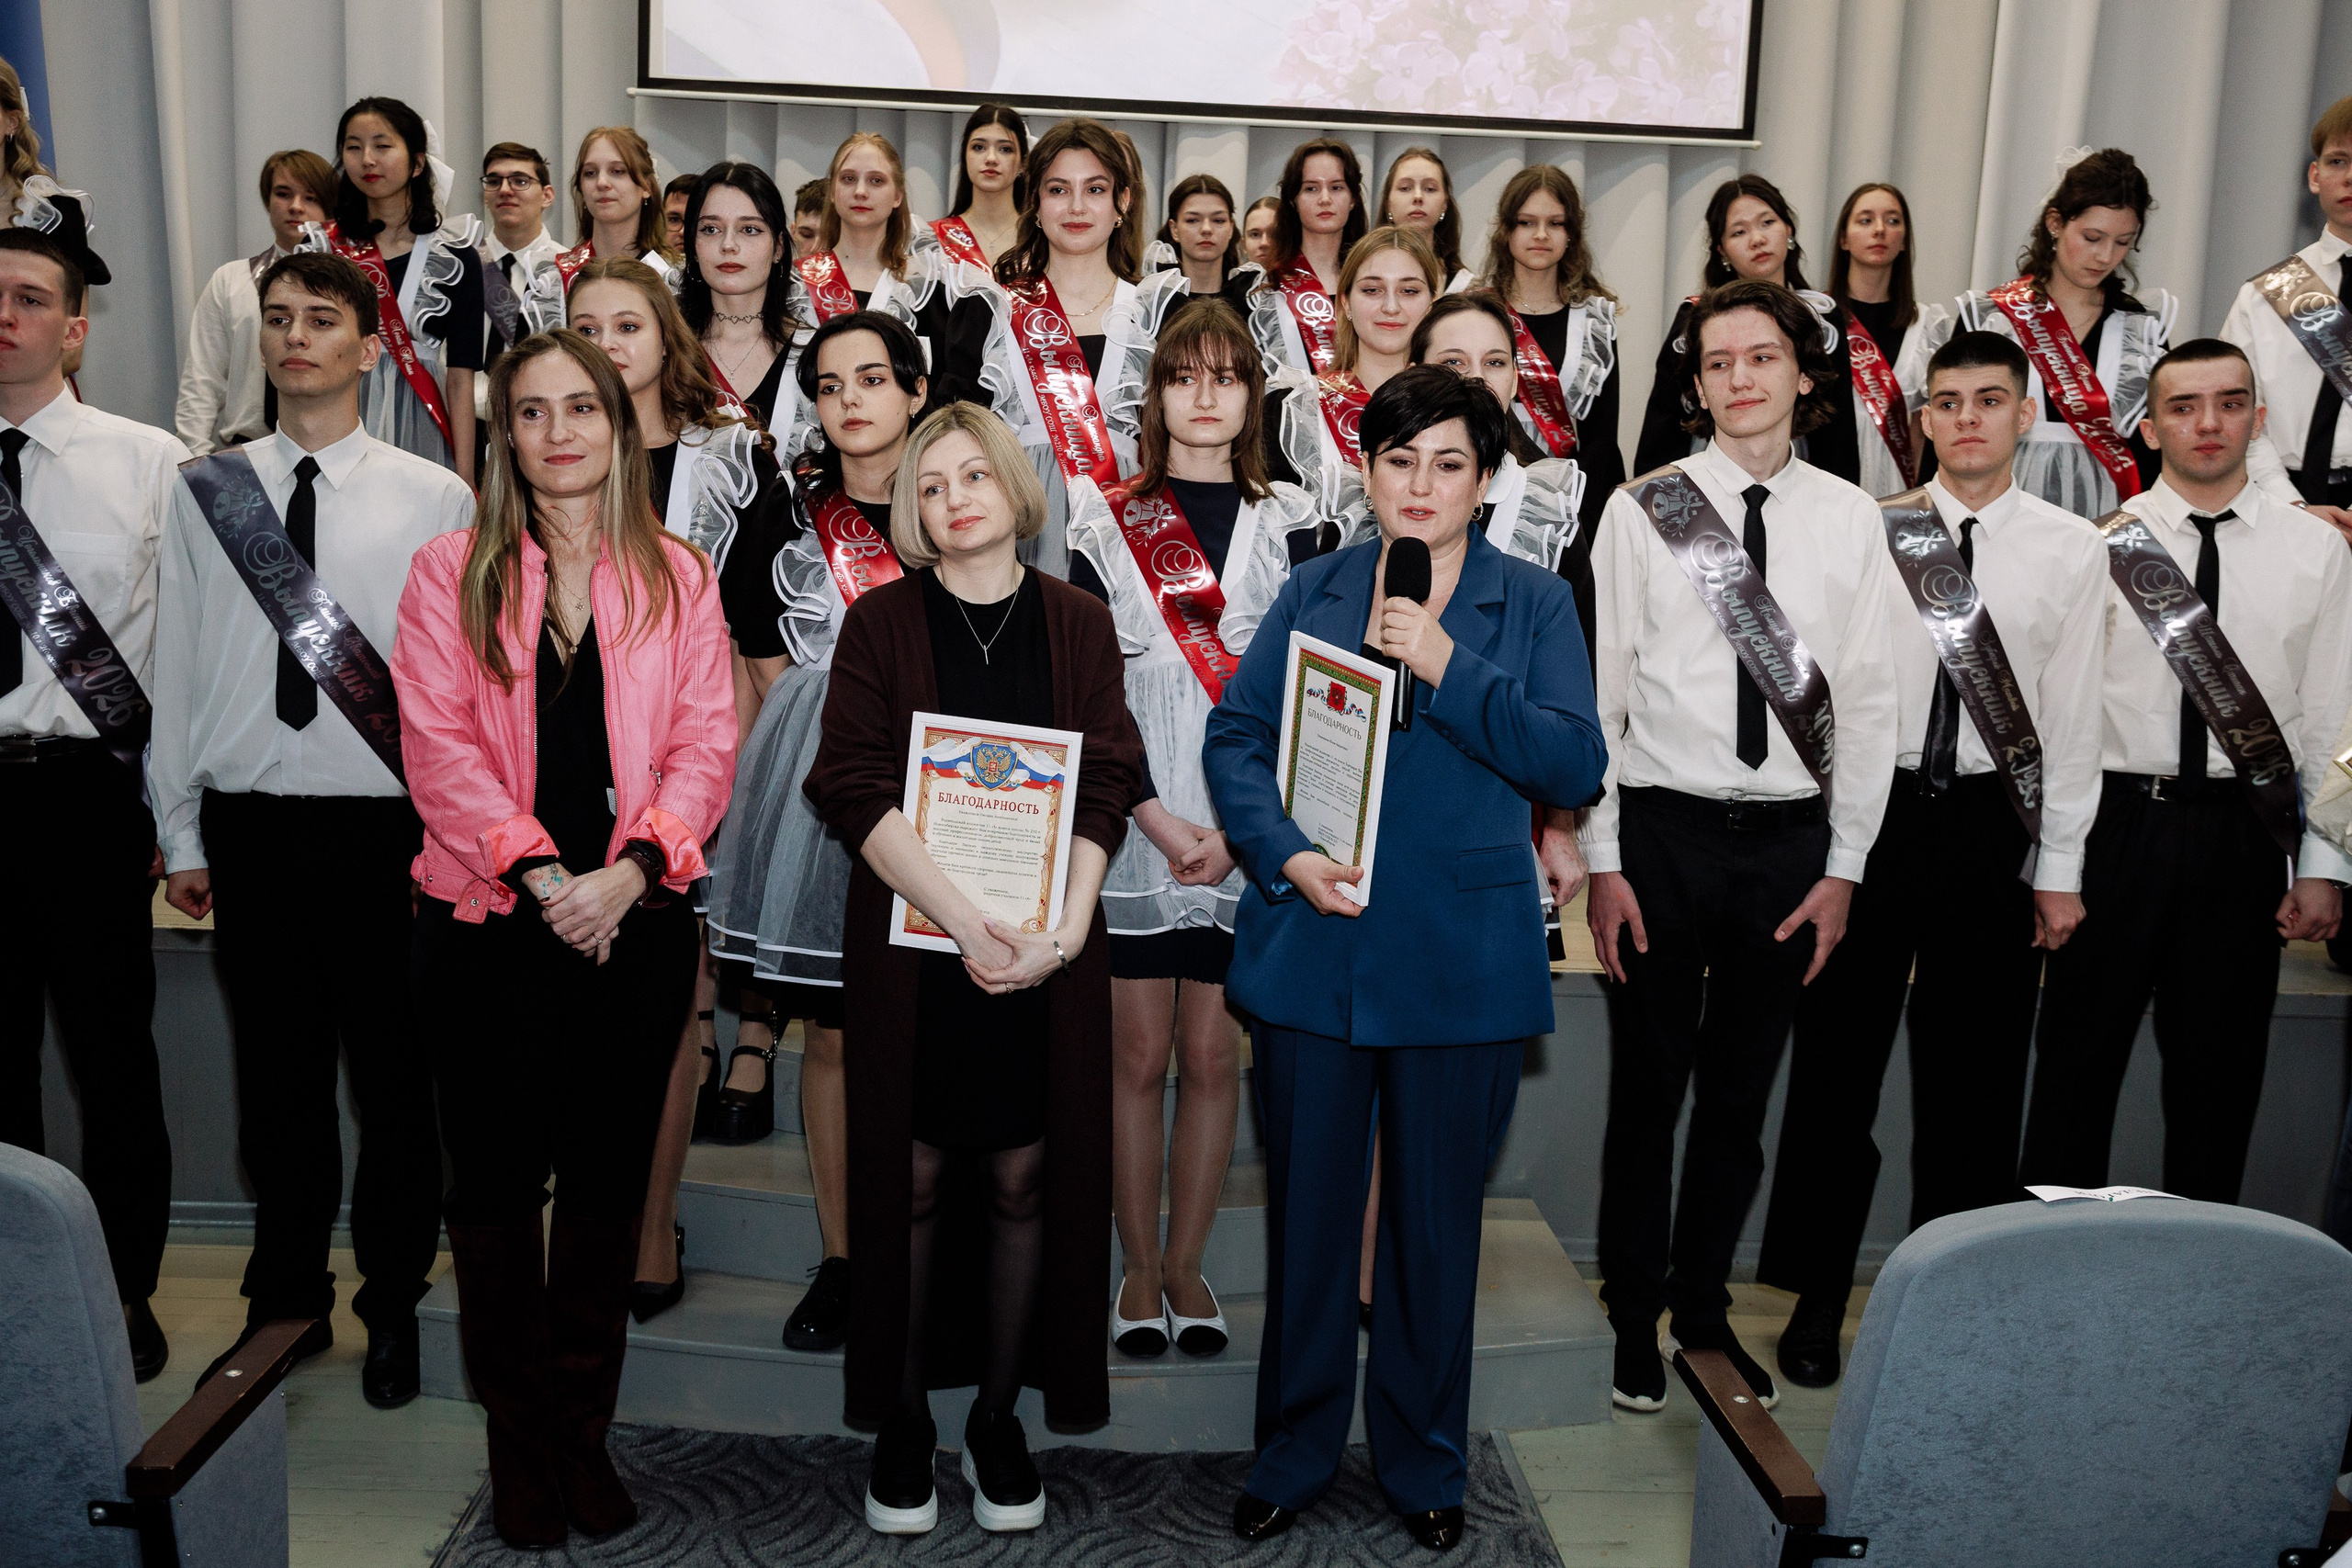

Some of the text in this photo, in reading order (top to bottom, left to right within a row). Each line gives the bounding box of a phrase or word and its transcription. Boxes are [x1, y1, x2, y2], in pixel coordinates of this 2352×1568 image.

[2006, 291, 2088, 416] Выпускница
[1023, 308, 1095, 475] Выпускница
[1027, 364, 1038, 380] класс
[1037, 393, 1050, 415] МБОУ
[1045, 415, 1056, 434] СОШ
[1051, 433, 1063, 452] №210
[1081, 404, 1105, 462] Александра
[831, 560, 840, 570] 11
[54, 585, 88, 631] Евгений
[243, 532, 374, 703] Выпускник
[308, 587, 345, 632] Климов
[1151, 540, 1236, 688] Выпускн
[1690, 532, 1806, 702] Выпускник
[1754, 594, 1787, 637] Немцев
[2131, 560, 2242, 718] Выпускник
[290, 639, 310, 661] МБОУ
[307, 660, 324, 679] СОШ
[1182, 644, 1199, 666] МБОУ
[1713, 610, 1729, 627] класс
[1732, 637, 1750, 660] МБОУ
[1746, 658, 1761, 677] СОШ
[1756, 675, 1772, 695] №210
[1921, 564, 2015, 733] Выпускник
[65, 648, 147, 727] 2026
[1307, 708, 1362, 739] БЛАГОДАРНОСТЬ
[2227, 718, 2291, 786] 2026
[937, 792, 1040, 815] БЛАГОДАРНОСТЬ
